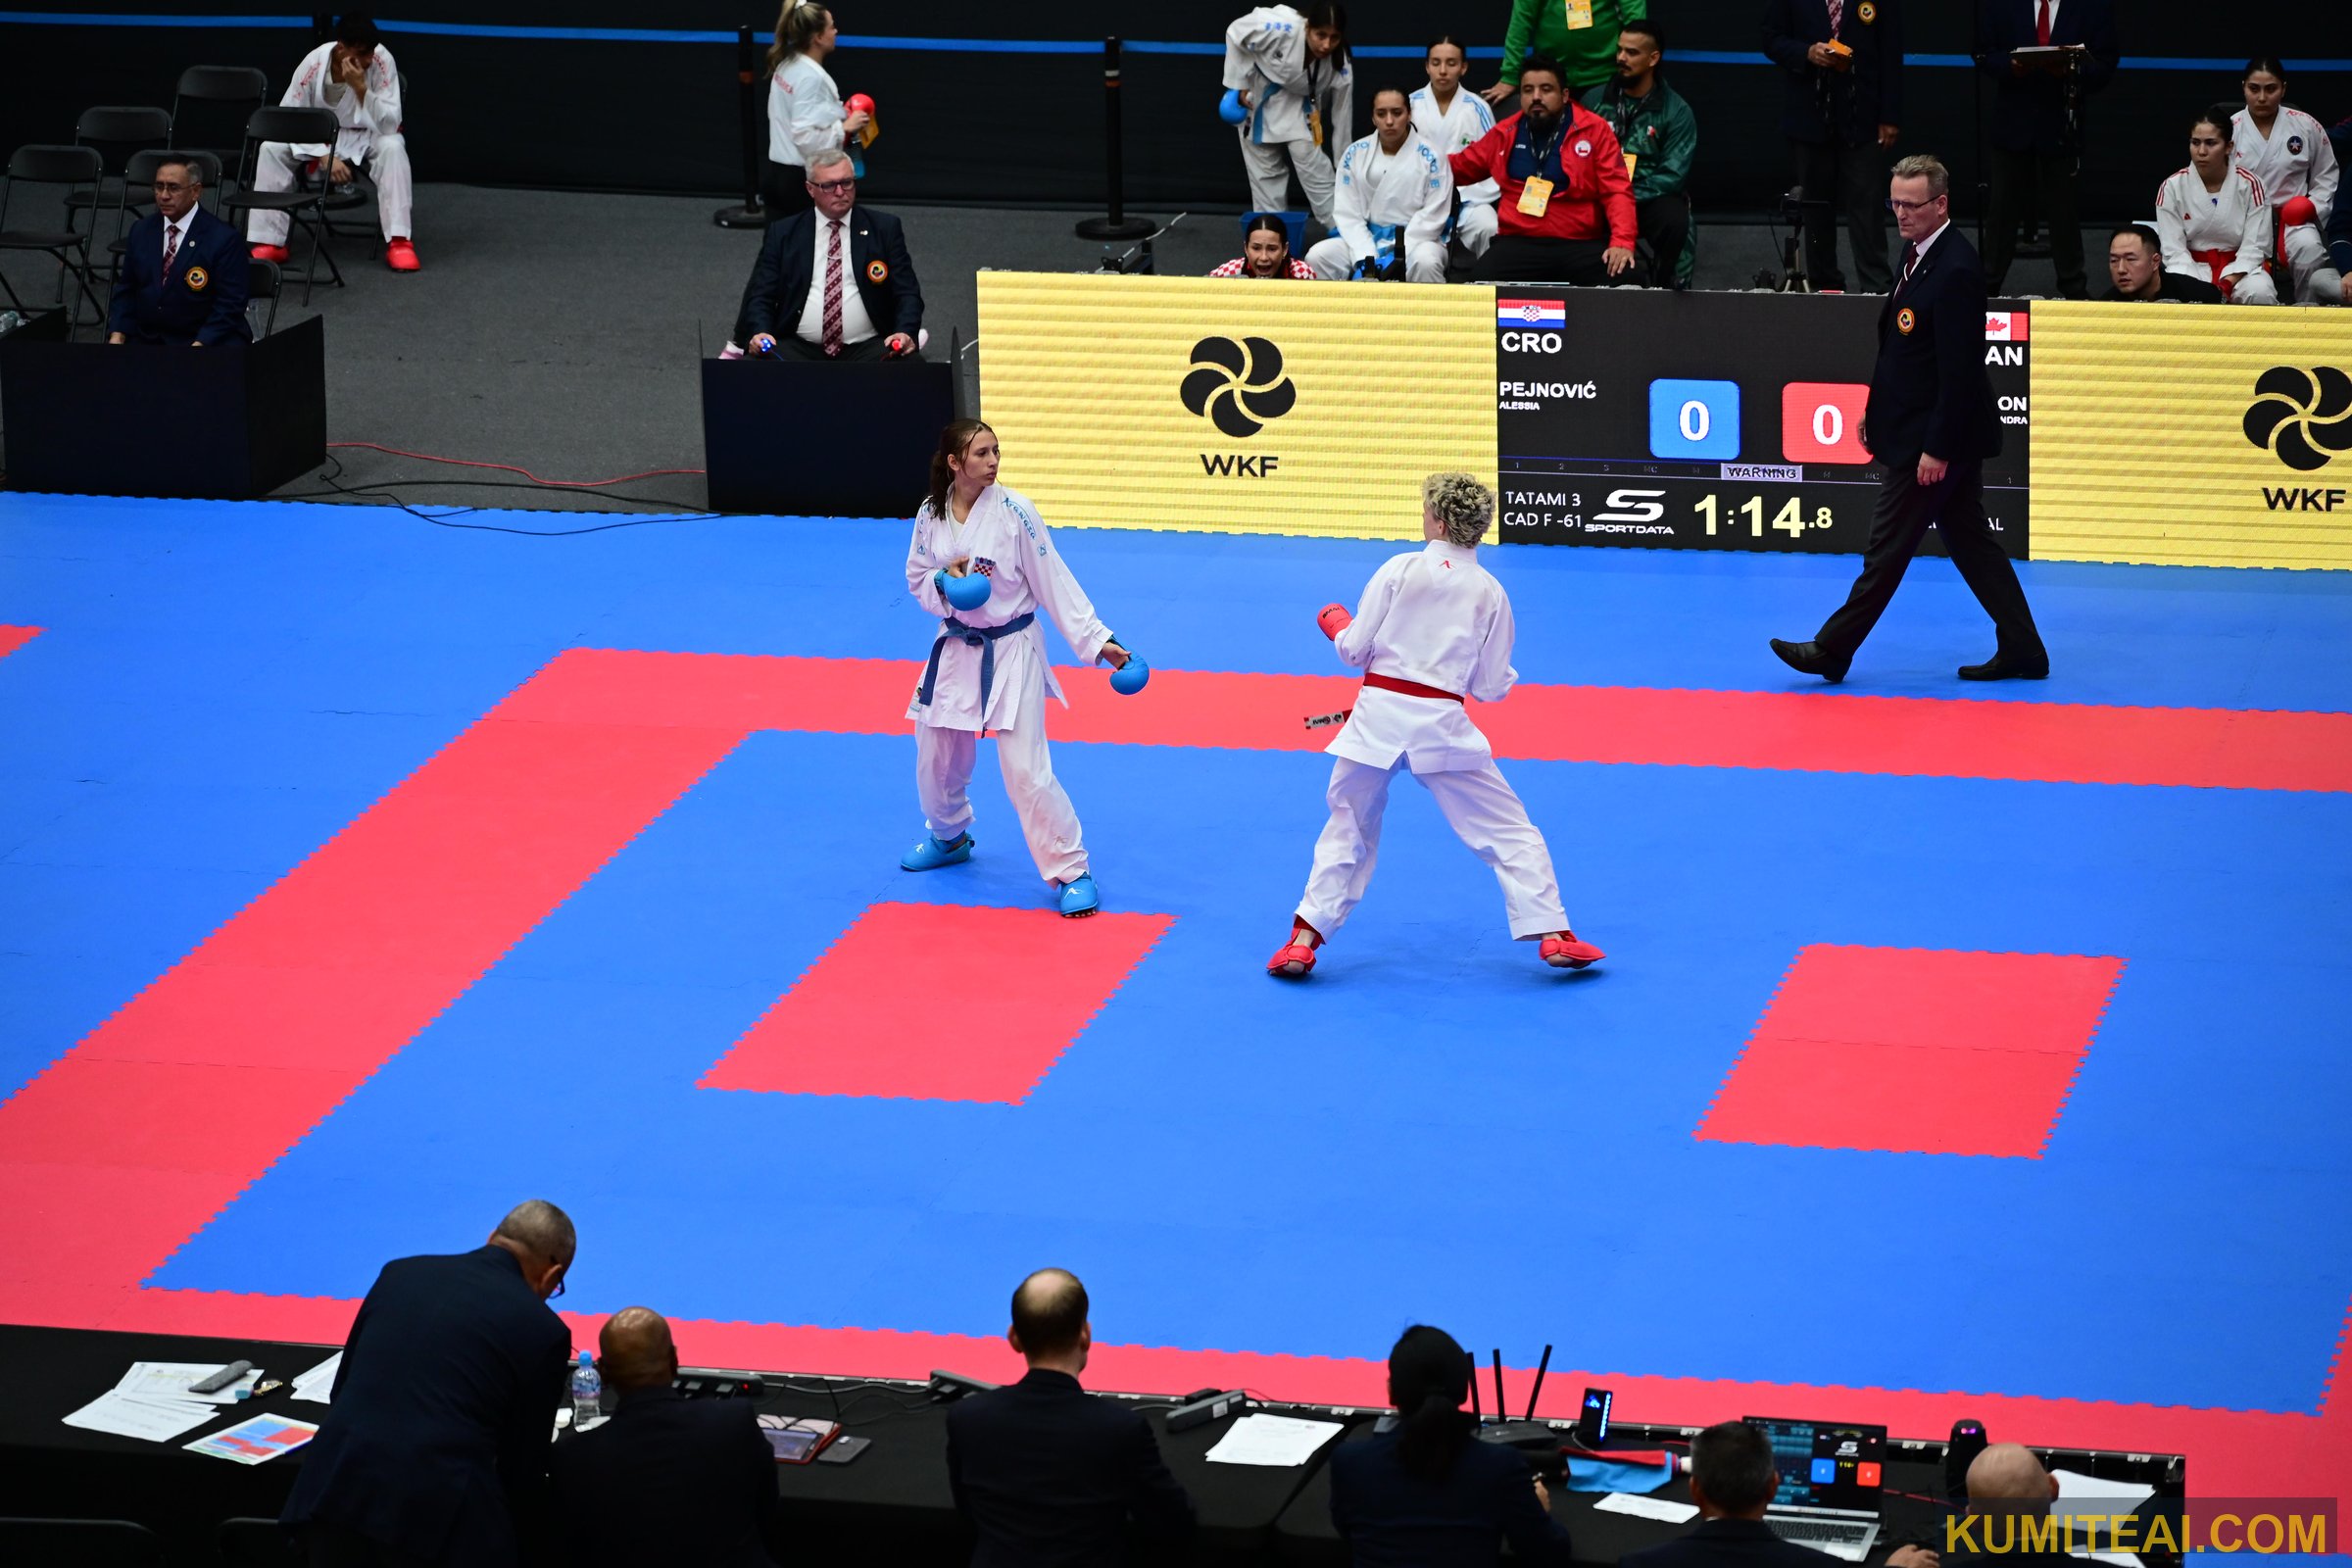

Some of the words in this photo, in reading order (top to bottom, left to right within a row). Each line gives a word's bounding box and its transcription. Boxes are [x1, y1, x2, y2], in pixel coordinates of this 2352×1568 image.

[1500, 331, 1563, 355] CRO
[1984, 345, 2023, 366] AN
[1498, 380, 1597, 399] PEJNOVIĆ
[1498, 401, 1541, 411] ALESSIA
[1997, 396, 2028, 412] ON
[1679, 400, 1710, 442] 0
[1812, 404, 1843, 446] 0
[2000, 416, 2028, 424] NDRA
[1200, 454, 1279, 478] WKF
[1727, 466, 1797, 479] WARNING
[1505, 491, 1566, 507] TATAMI
[1571, 493, 1582, 507] 3
[2262, 487, 2347, 512] WKF
[1503, 512, 1539, 526] CAD
[1544, 514, 1552, 527] F
[1556, 514, 1582, 528] -61
[1693, 494, 1833, 539] 1:14.8
[1585, 523, 1675, 535] SPORTDATA
